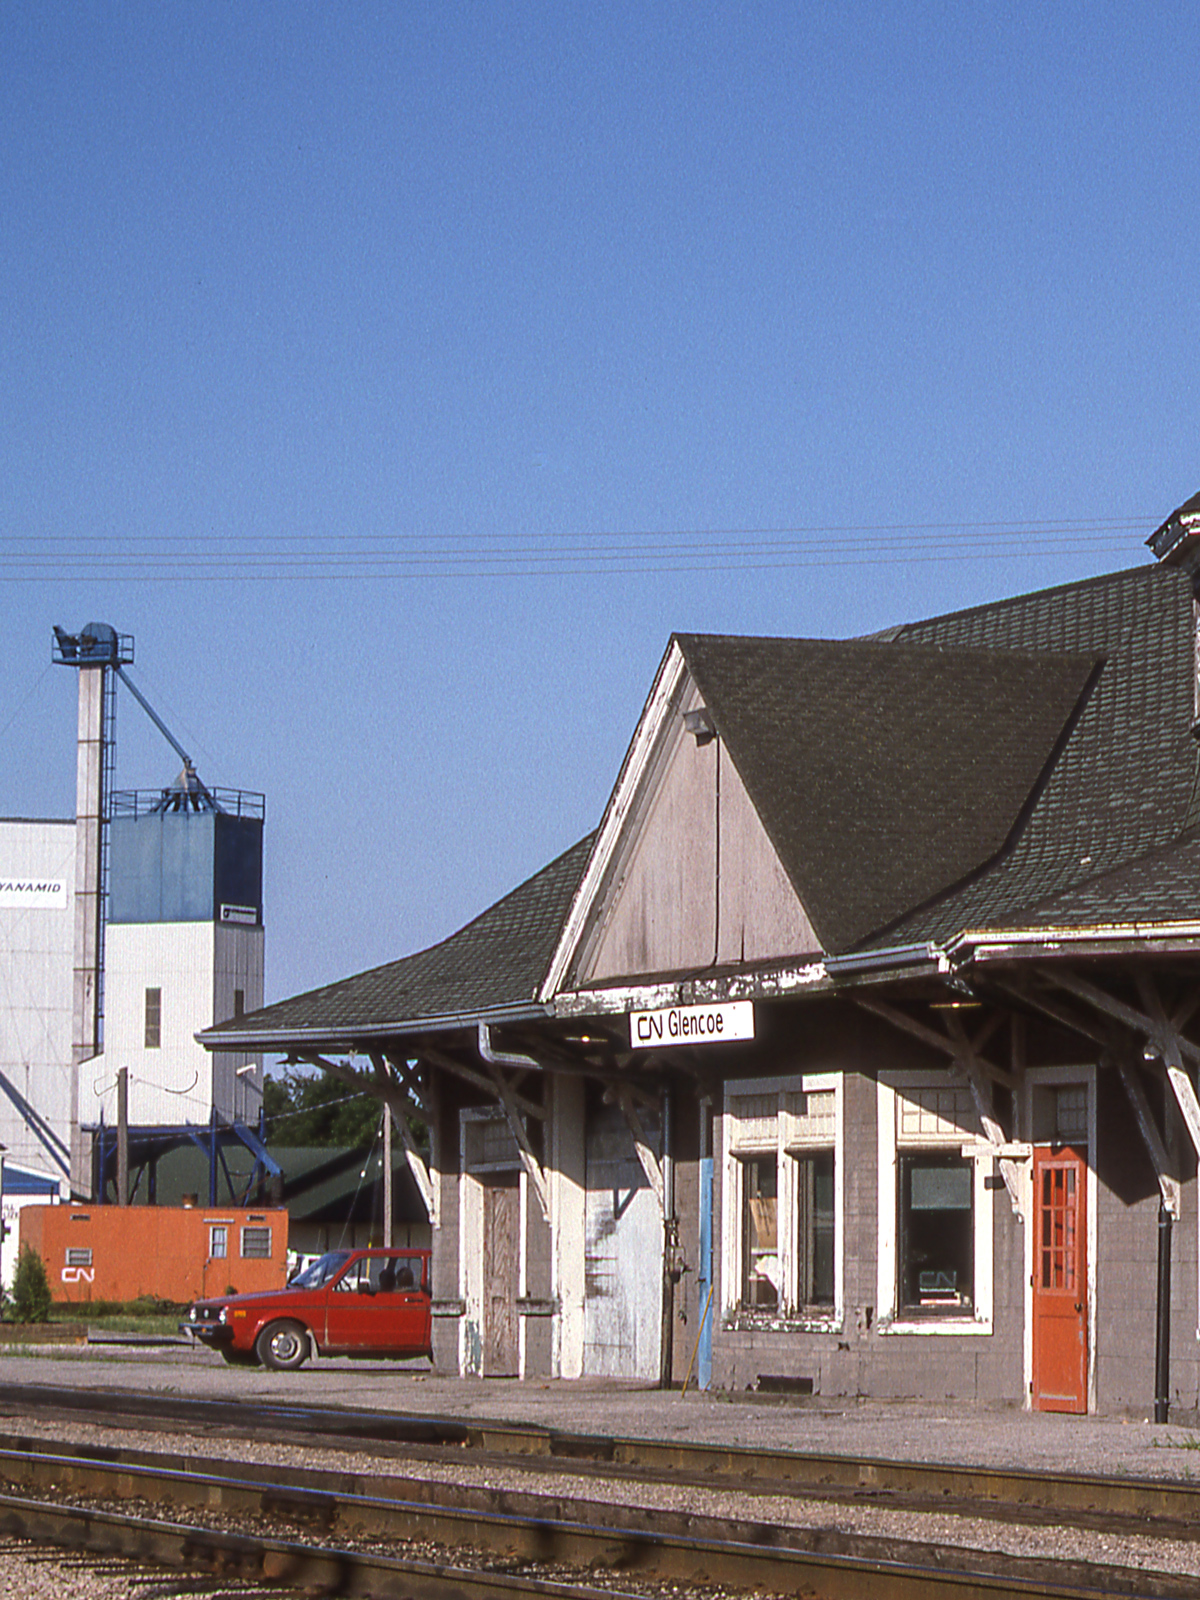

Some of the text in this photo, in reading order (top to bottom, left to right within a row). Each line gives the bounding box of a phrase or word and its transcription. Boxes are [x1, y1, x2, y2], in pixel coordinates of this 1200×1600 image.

[637, 1009, 724, 1040] CN Glencoe
[61, 1267, 95, 1282] CN
[919, 1270, 957, 1287] CN
